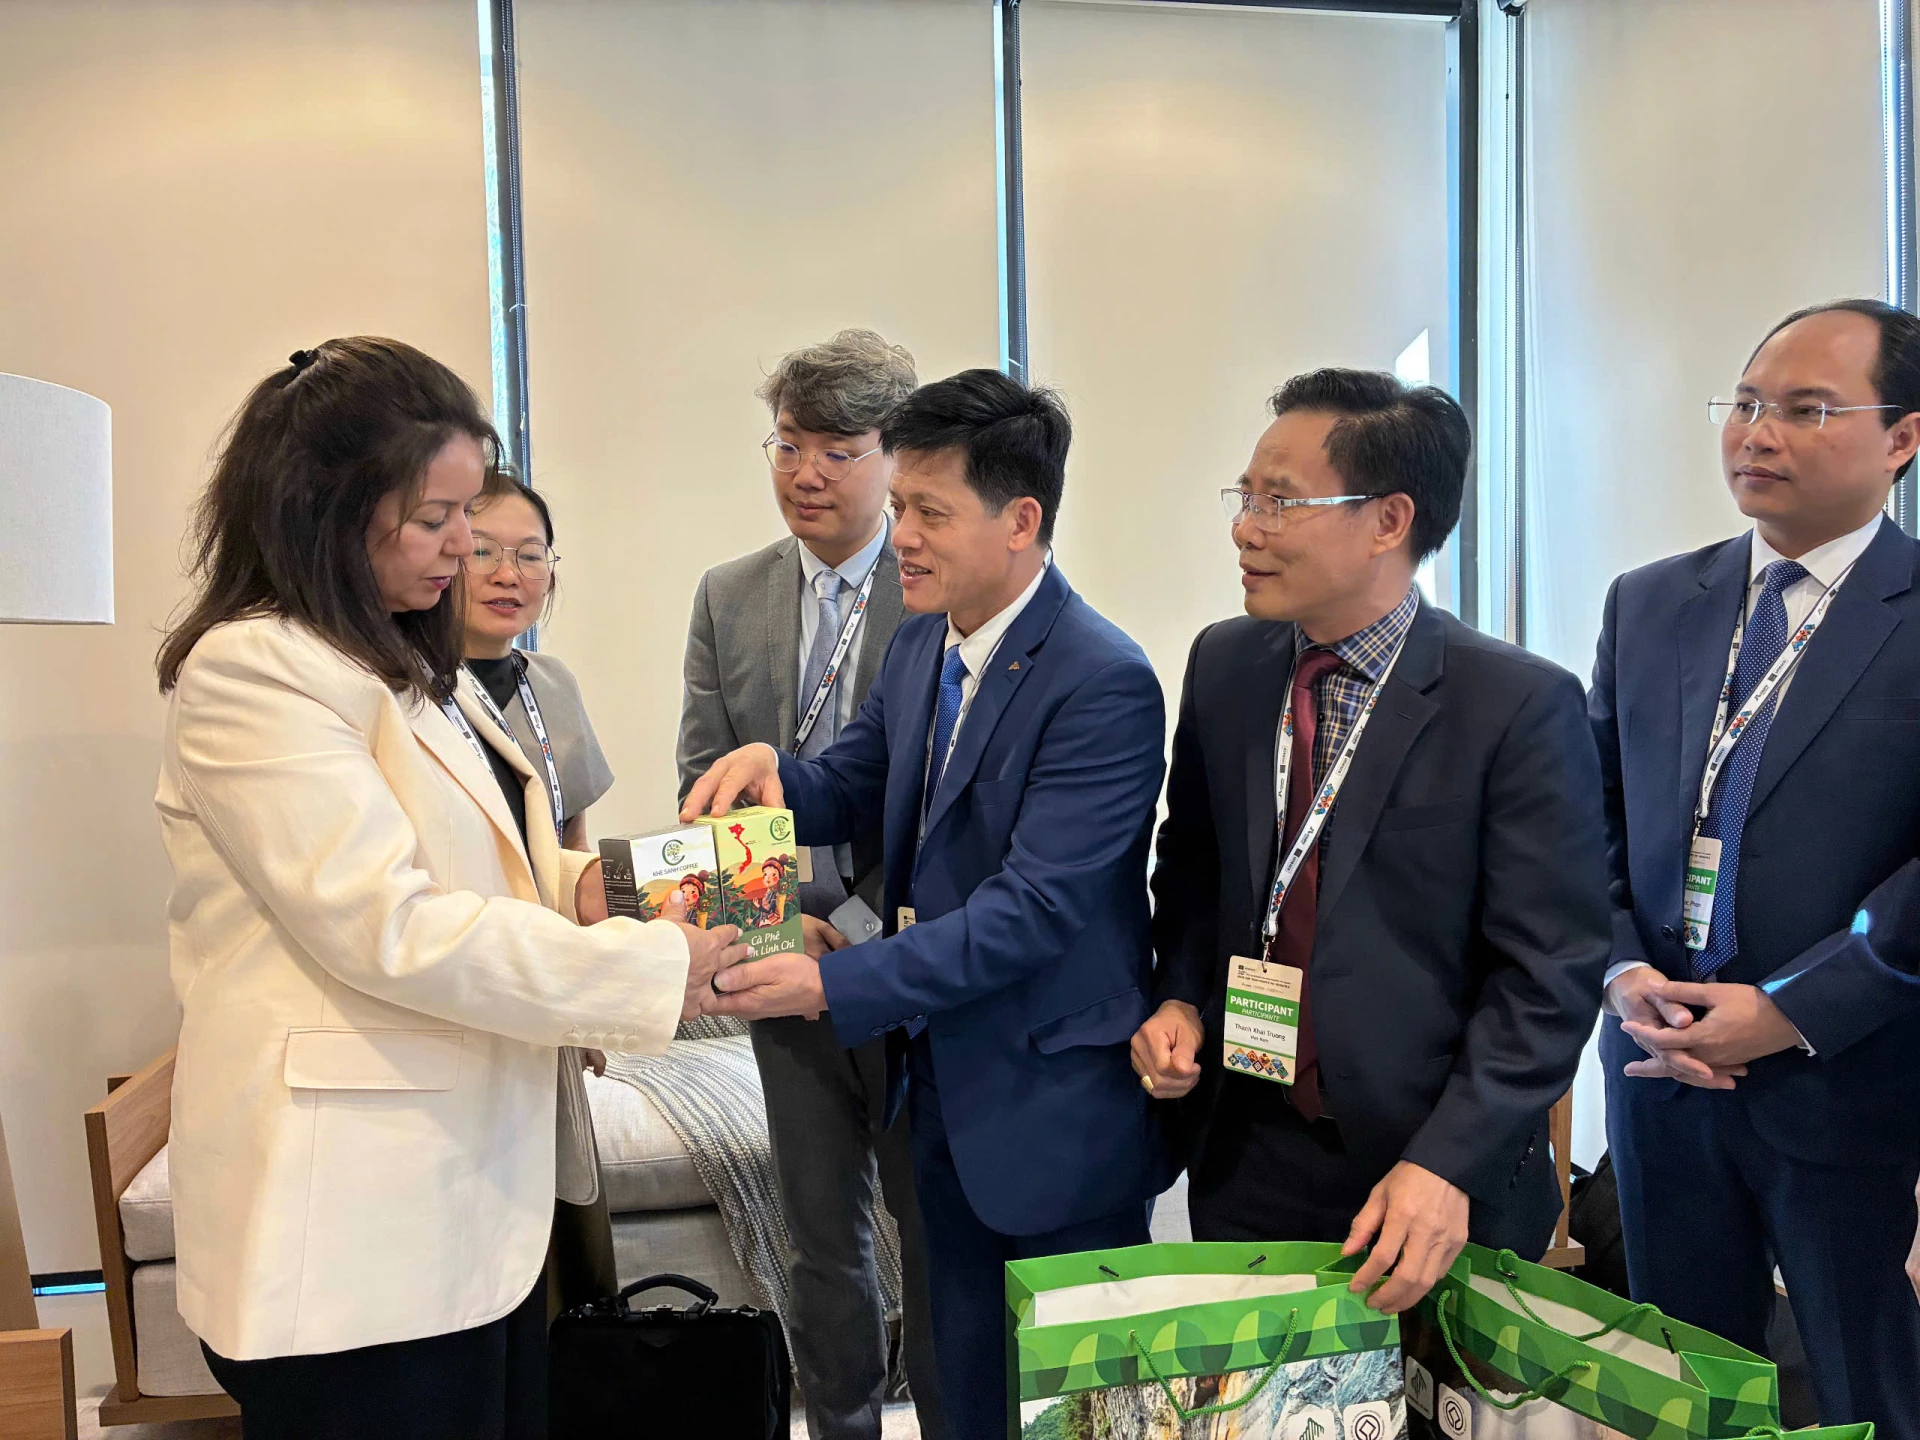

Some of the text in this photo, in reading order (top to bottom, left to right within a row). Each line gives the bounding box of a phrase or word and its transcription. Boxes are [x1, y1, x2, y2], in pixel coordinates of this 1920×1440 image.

[664, 867, 679, 875] SANH
[679, 863, 699, 872] COFFEE
[751, 930, 780, 946] Cà Phê
[760, 943, 779, 955] Linh
[781, 938, 795, 950] Chi
[1230, 995, 1294, 1017] PARTICIPANT
[1241, 1008, 1280, 1022] PARTICIPANTE
[1235, 1023, 1252, 1032] Thanh
[1267, 1030, 1286, 1041] Truong
